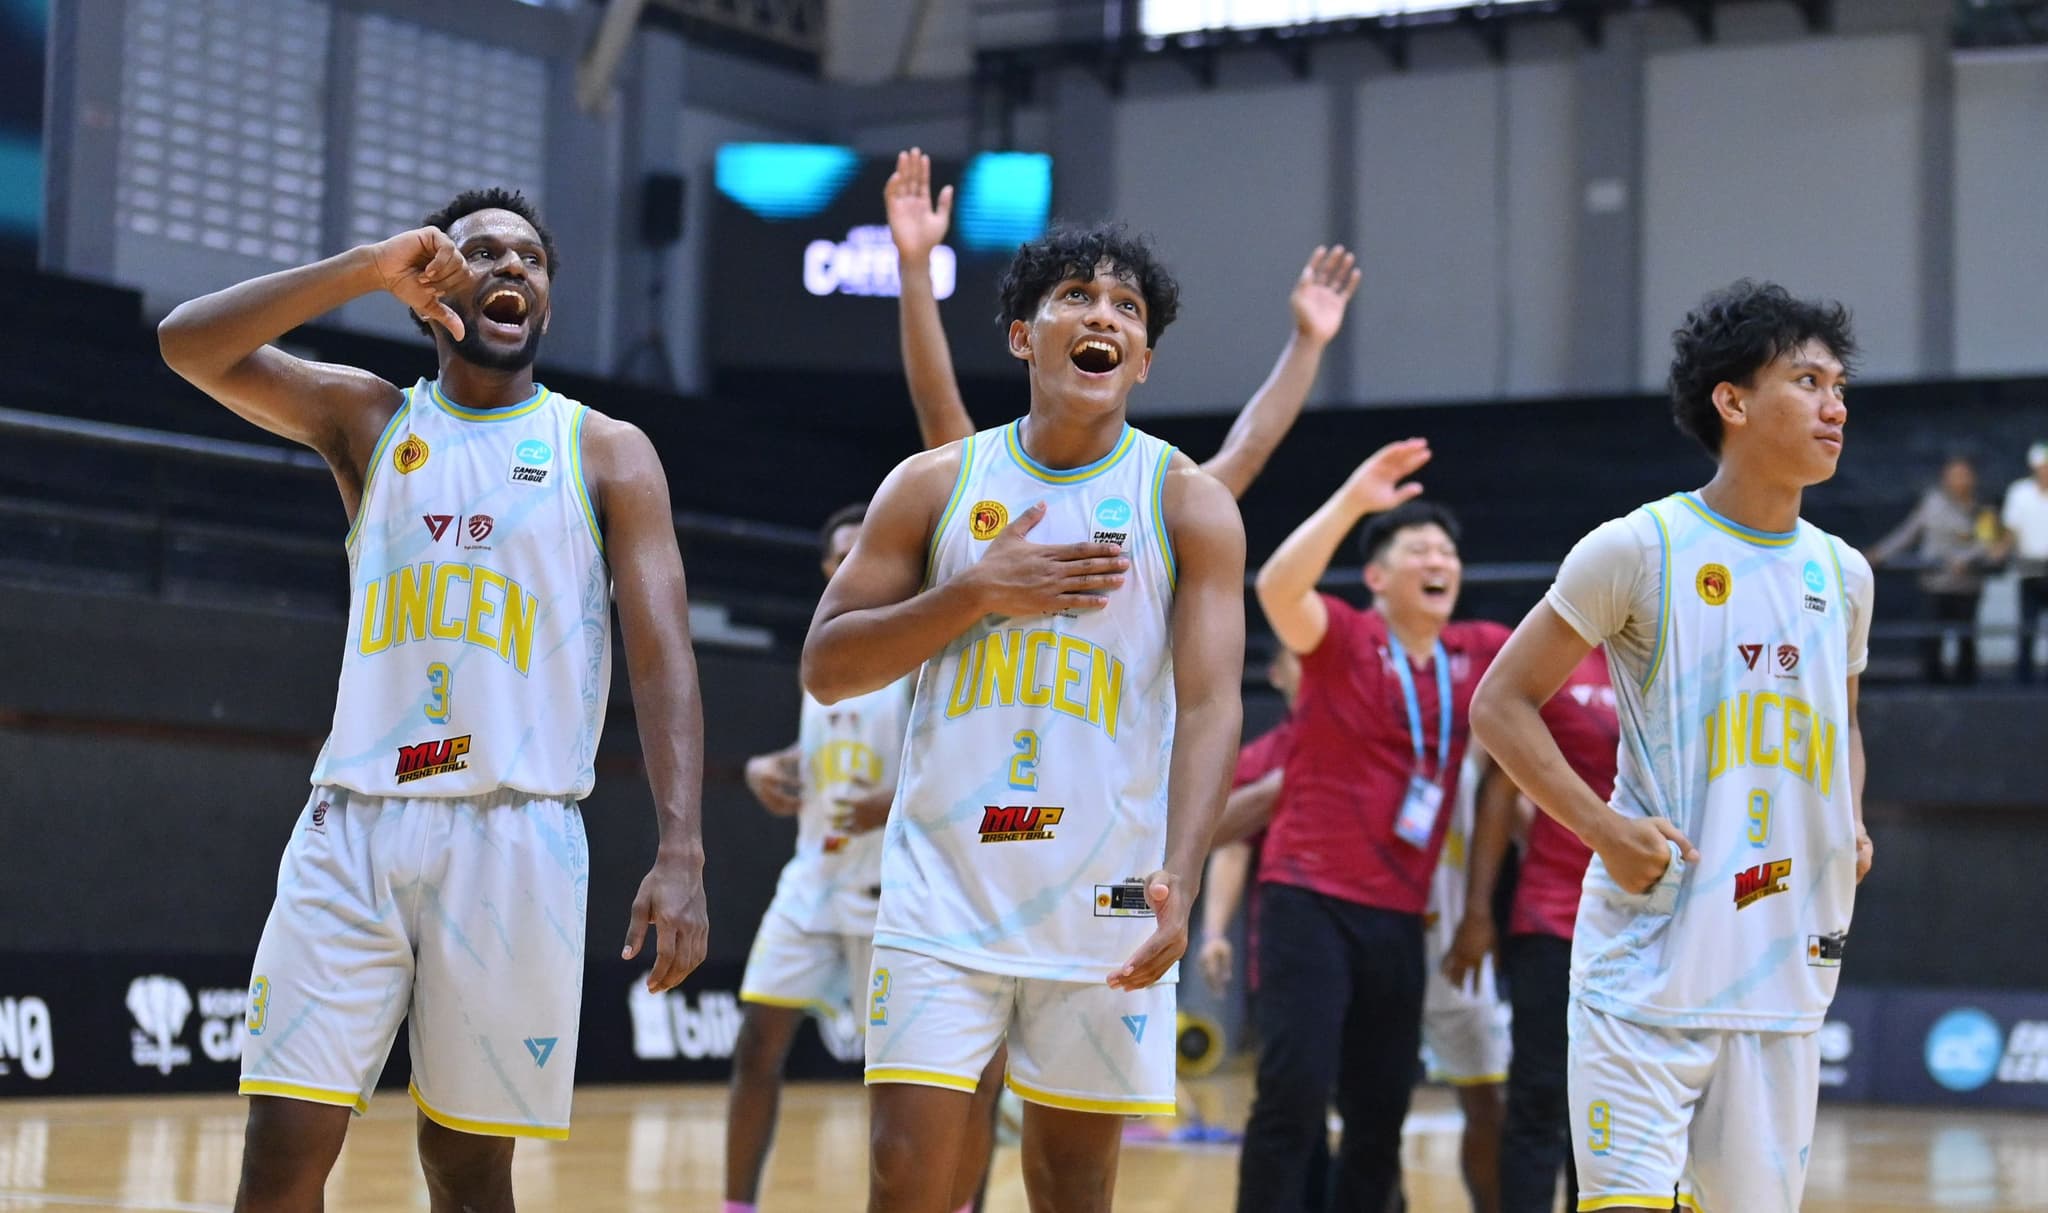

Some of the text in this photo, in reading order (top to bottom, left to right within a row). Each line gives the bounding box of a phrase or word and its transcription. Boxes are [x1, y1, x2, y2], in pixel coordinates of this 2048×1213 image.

[512, 472, 544, 483] LEAGUE
[513, 466, 548, 477] CAMPUS
[1094, 531, 1127, 541] CAMPUS
[357, 561, 538, 678] UNCEN
[424, 662, 453, 725] 3
[944, 628, 1125, 742] UNCEN
[397, 760, 468, 784] BASKETBALL
[1008, 729, 1041, 792] 2
[1703, 689, 1837, 801] UNCEN
[980, 831, 1055, 843] BASKETBALL
[1747, 787, 1774, 848] 9
[247, 975, 271, 1035] 3
[870, 968, 893, 1026] 2
[1588, 1100, 1614, 1157] 9
